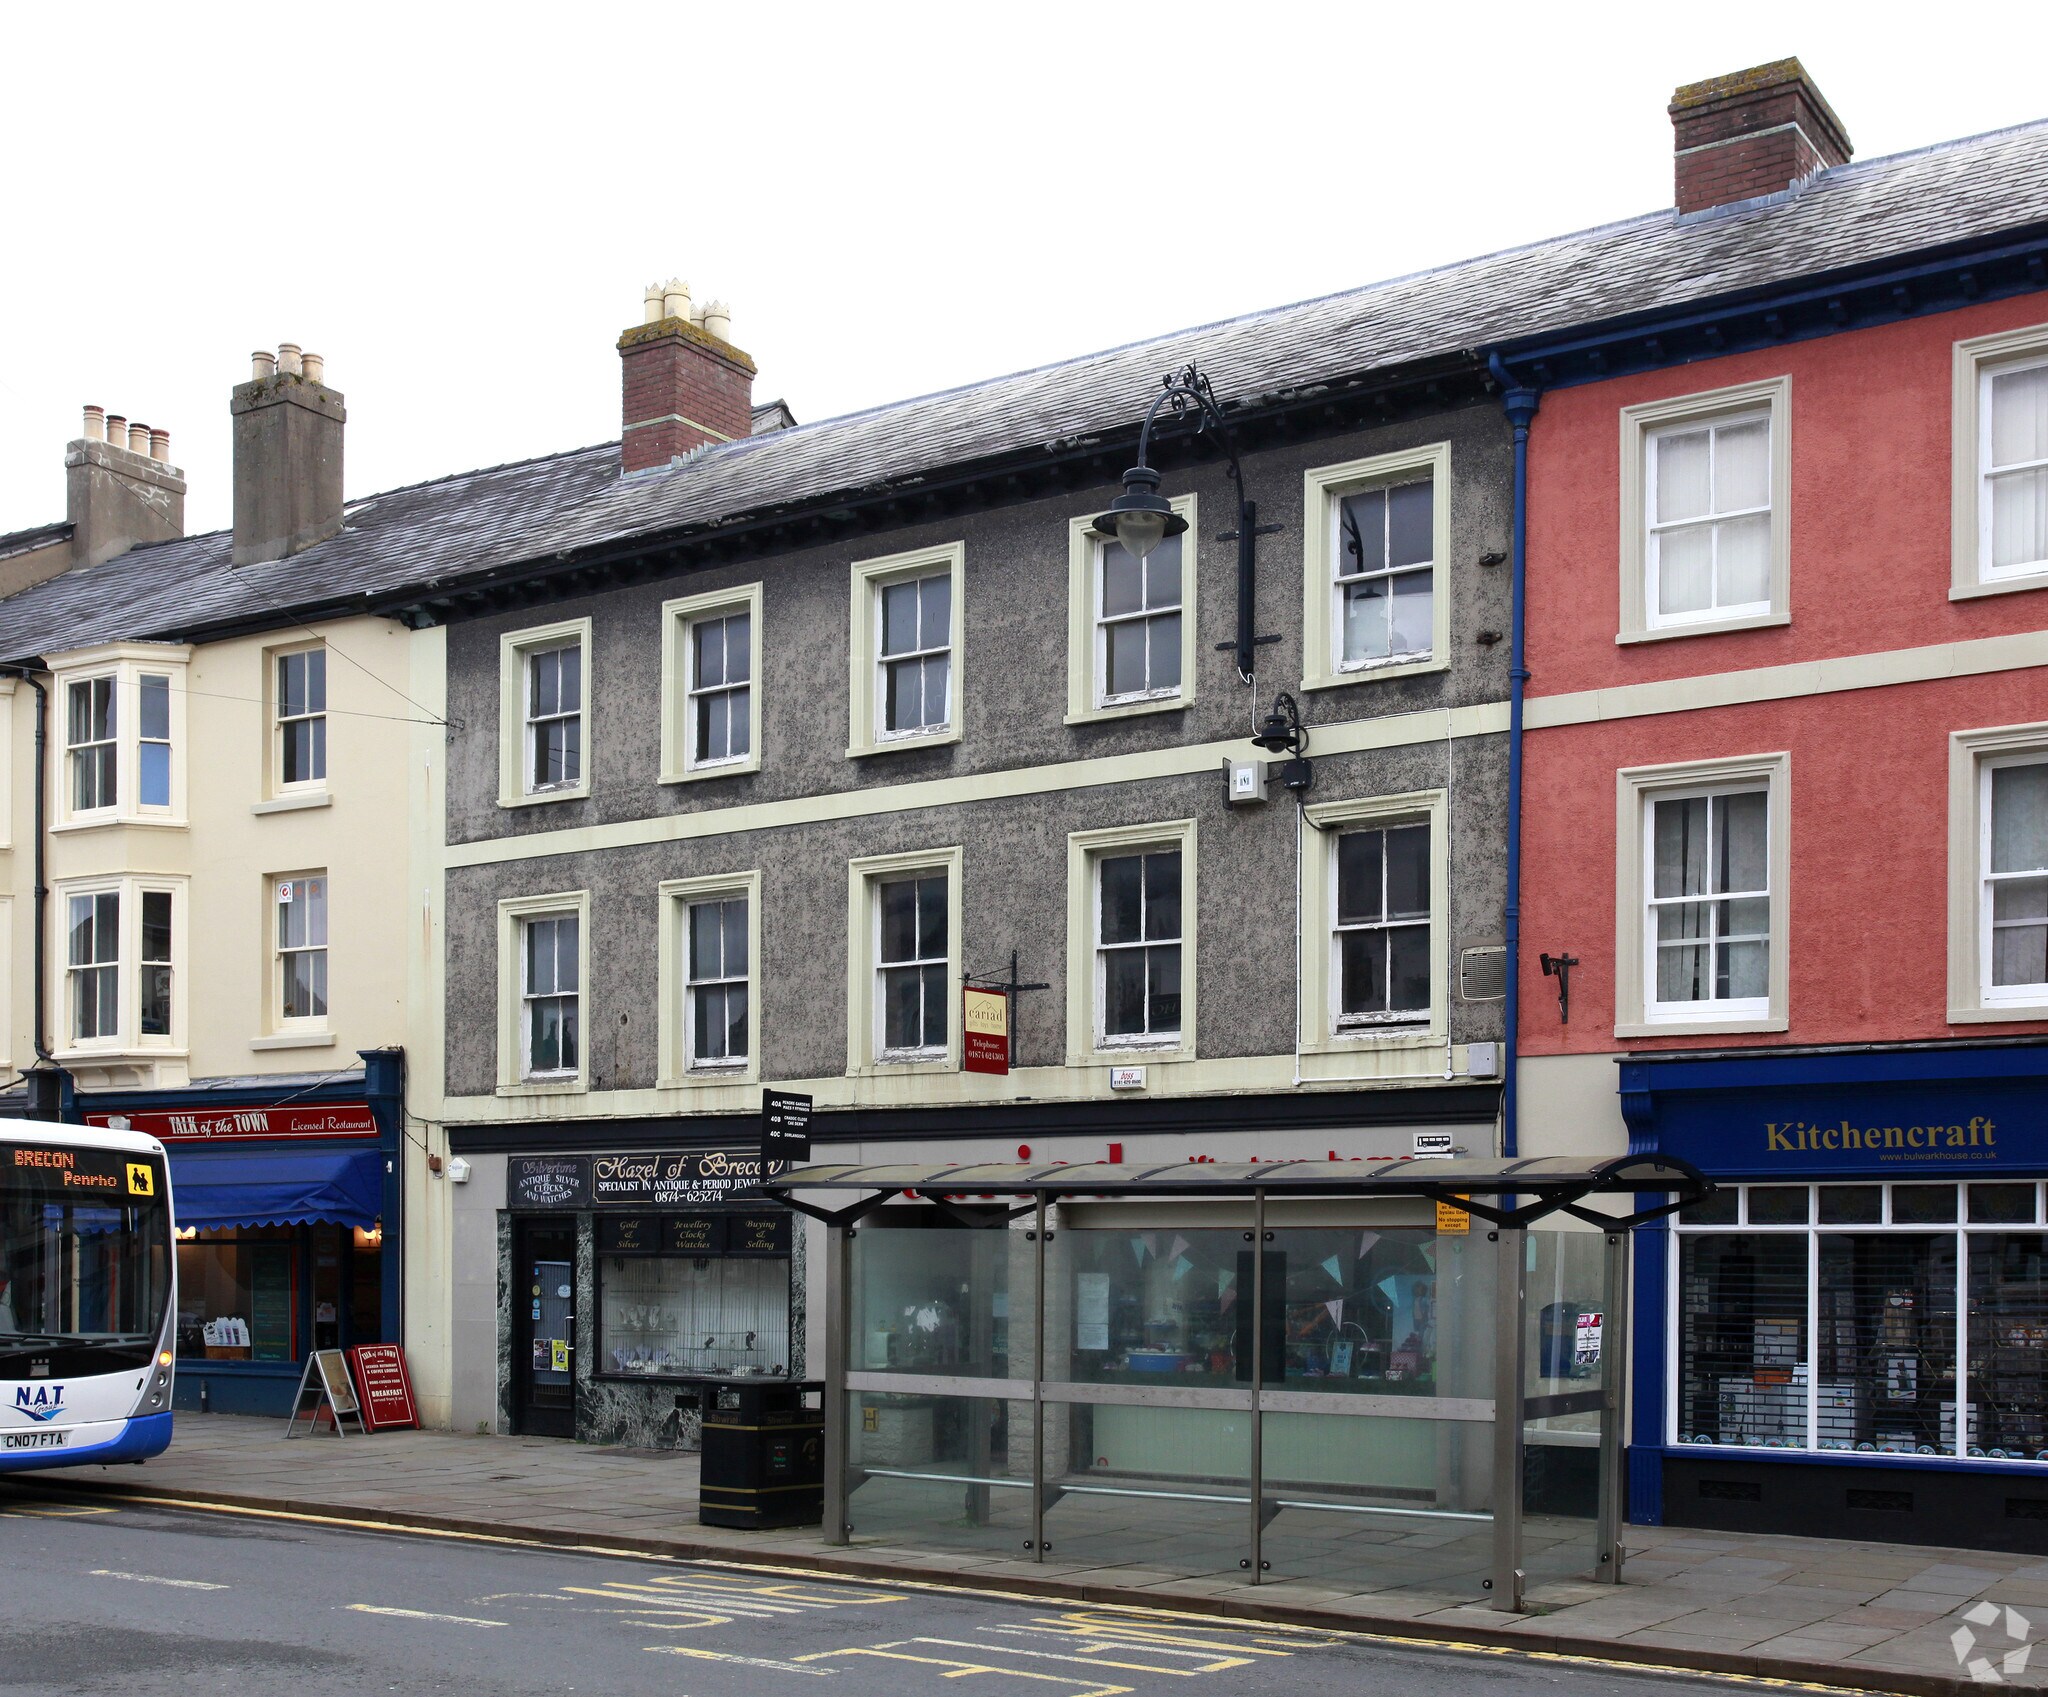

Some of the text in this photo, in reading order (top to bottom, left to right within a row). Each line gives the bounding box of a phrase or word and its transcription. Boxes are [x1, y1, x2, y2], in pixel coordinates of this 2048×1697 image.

[968, 1008, 1002, 1022] cariad
[770, 1100, 782, 1108] 40A
[168, 1113, 270, 1138] TALK of the TOWN
[290, 1116, 371, 1131] Licensed Restaurant
[1764, 1116, 1998, 1152] Kitchencraft
[14, 1149, 75, 1169] BRECON
[1879, 1151, 1998, 1161] www.bulwarkhouse.co.uk
[596, 1154, 660, 1182] Hazel
[664, 1155, 688, 1180] of
[64, 1170, 118, 1187] Penrho
[518, 1174, 580, 1188] ANTIQUE SILVER
[534, 1184, 564, 1193] CLOCKS
[598, 1180, 640, 1192] SPECIALIST
[642, 1180, 651, 1191] IN
[653, 1180, 690, 1191] ANTIQUE
[702, 1179, 731, 1190] PERIOD
[524, 1188, 572, 1204] AND WATCHES
[619, 1220, 640, 1230] Gold
[673, 1220, 712, 1230] Jewellery
[745, 1220, 776, 1230] Buying
[679, 1230, 706, 1240] Clocks
[616, 1240, 640, 1248] Silver
[676, 1240, 710, 1249] Watches
[746, 1240, 775, 1250] Selling
[16, 1386, 64, 1406] N.A.T.
[371, 1388, 403, 1398] BREAKFAST
[6, 1433, 63, 1448] CN07 FTA
